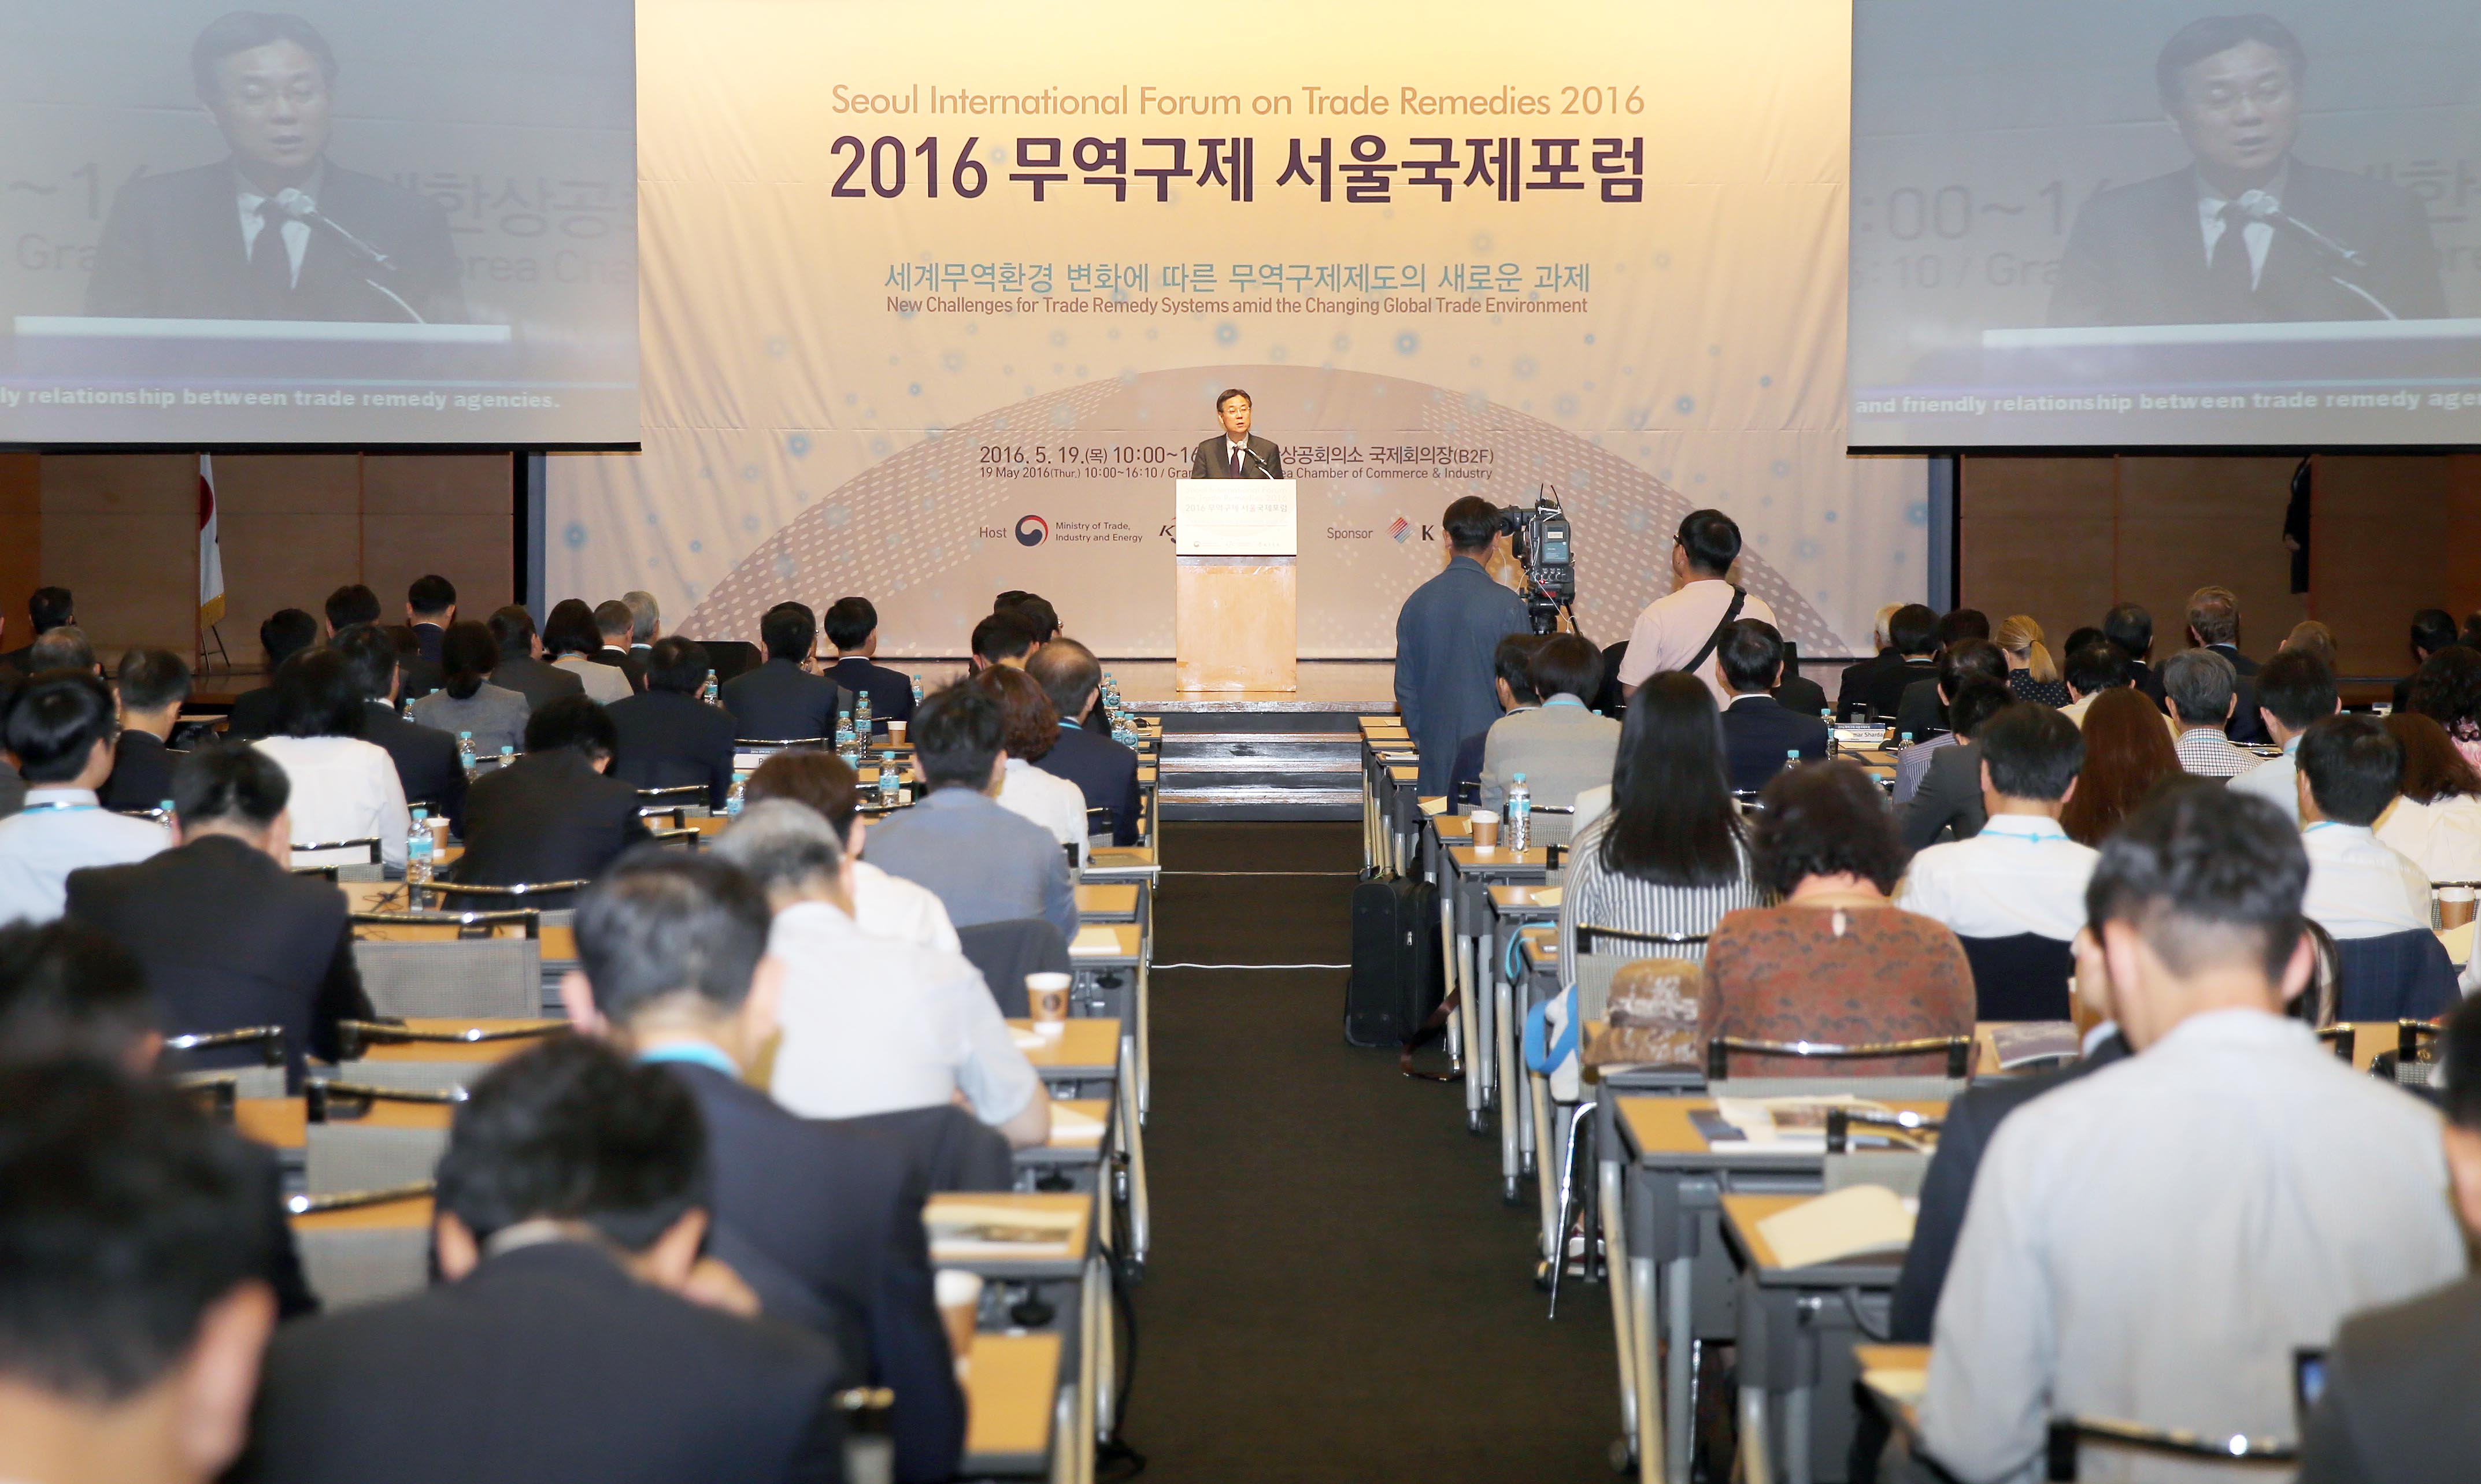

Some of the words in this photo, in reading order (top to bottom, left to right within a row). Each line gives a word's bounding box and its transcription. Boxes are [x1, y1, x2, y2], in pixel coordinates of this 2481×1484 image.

[832, 84, 918, 114] Seoul
[931, 85, 1127, 115] International
[1141, 87, 1241, 115] Forum
[1252, 95, 1291, 115] on
[1302, 86, 1389, 115] Trade
[1401, 85, 1551, 115] Remedies
[1560, 86, 1645, 115] 2016
[830, 135, 988, 199] 2016
[1009, 137, 1253, 202] 무역구제
[1276, 135, 1643, 203] 서울국제포럼
[884, 262, 1053, 294] 세계무역환경
[1067, 263, 1149, 294] 변화에
[1162, 264, 1217, 293] 따른
[1229, 263, 1426, 294] 무역구제제도의
[1438, 263, 1523, 293] 새로운
[1534, 263, 1589, 293] 과제
[887, 296, 923, 313] New
[926, 296, 1013, 316] Challenges
[1016, 296, 1039, 313] for
[1043, 296, 1088, 313] Trade
[1093, 296, 1158, 316] Remedy
[1161, 296, 1230, 315] Systems
[1232, 296, 1273, 313] amid
[1276, 296, 1302, 313] the
[1305, 296, 1380, 316] Changing
[1384, 296, 1432, 313] Global
[1436, 296, 1482, 313] Trade
[1486, 296, 1588, 313] Environment
[28, 387, 175, 408] relationship
[183, 388, 287, 406] between
[295, 389, 356, 406] trade
[362, 391, 447, 411] remedy
[454, 391, 560, 411] agencies.
[1856, 396, 1896, 414] and
[1902, 395, 1987, 415] friendly
[1994, 394, 2132, 413] relationship
[2140, 392, 2245, 410] between
[2254, 391, 2317, 409] trade
[2326, 389, 2420, 410] remedy
[980, 446, 1030, 464] 2016.
[1036, 446, 1051, 464] 5.
[1059, 447, 1108, 465] 19.(목)
[1279, 446, 1364, 465] 상공회의소
[1369, 446, 1494, 465] 국제회의장(B2F)
[980, 468, 993, 478] 19
[996, 468, 1020, 480] May
[1023, 468, 1080, 478] 2016(Thur.)
[1085, 468, 1158, 478] 10:00~16:10
[1297, 468, 1349, 478] Chamber
[1353, 468, 1363, 478] of
[1366, 468, 1428, 478] Commerce
[1432, 468, 1441, 478] &
[1445, 468, 1494, 481] Industry
[980, 526, 1008, 539] Host
[1056, 522, 1091, 532] Ministry
[1092, 522, 1102, 530] of
[1104, 522, 1130, 532] Trade,
[1327, 527, 1373, 541] Sponsor
[1056, 533, 1092, 544] Industry
[1093, 533, 1111, 542] and
[1113, 534, 1143, 544] Energy
